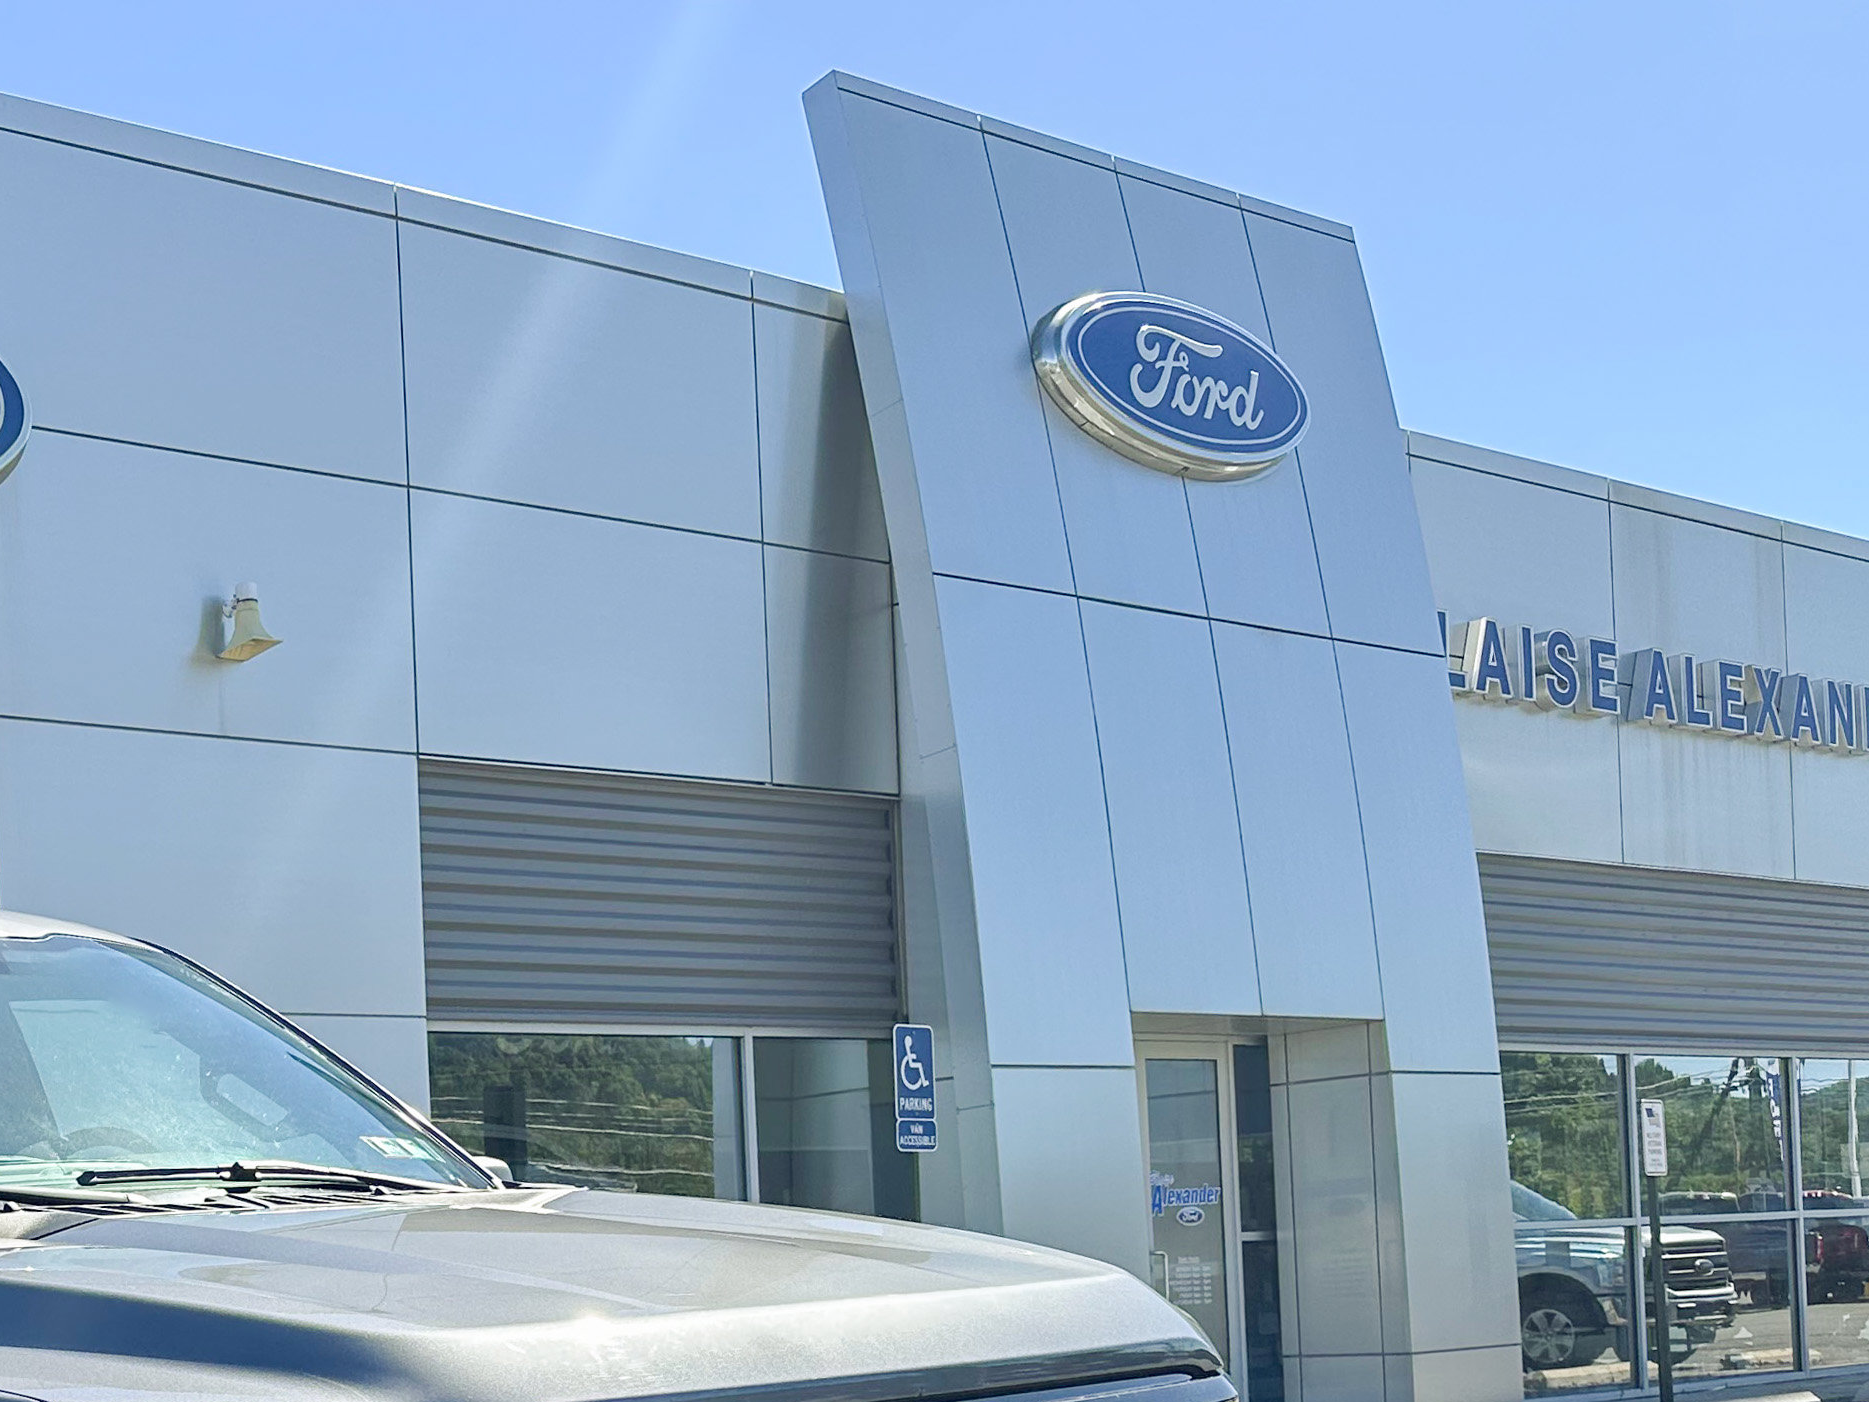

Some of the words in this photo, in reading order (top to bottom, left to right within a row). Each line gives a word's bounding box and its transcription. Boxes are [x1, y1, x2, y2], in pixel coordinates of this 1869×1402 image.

[1129, 324, 1264, 430] Ford
[899, 1097, 933, 1112] PARKING
[909, 1123, 924, 1135] VAN
[899, 1135, 936, 1146] ACCESSIBLE
[1150, 1182, 1222, 1217] Alexander
